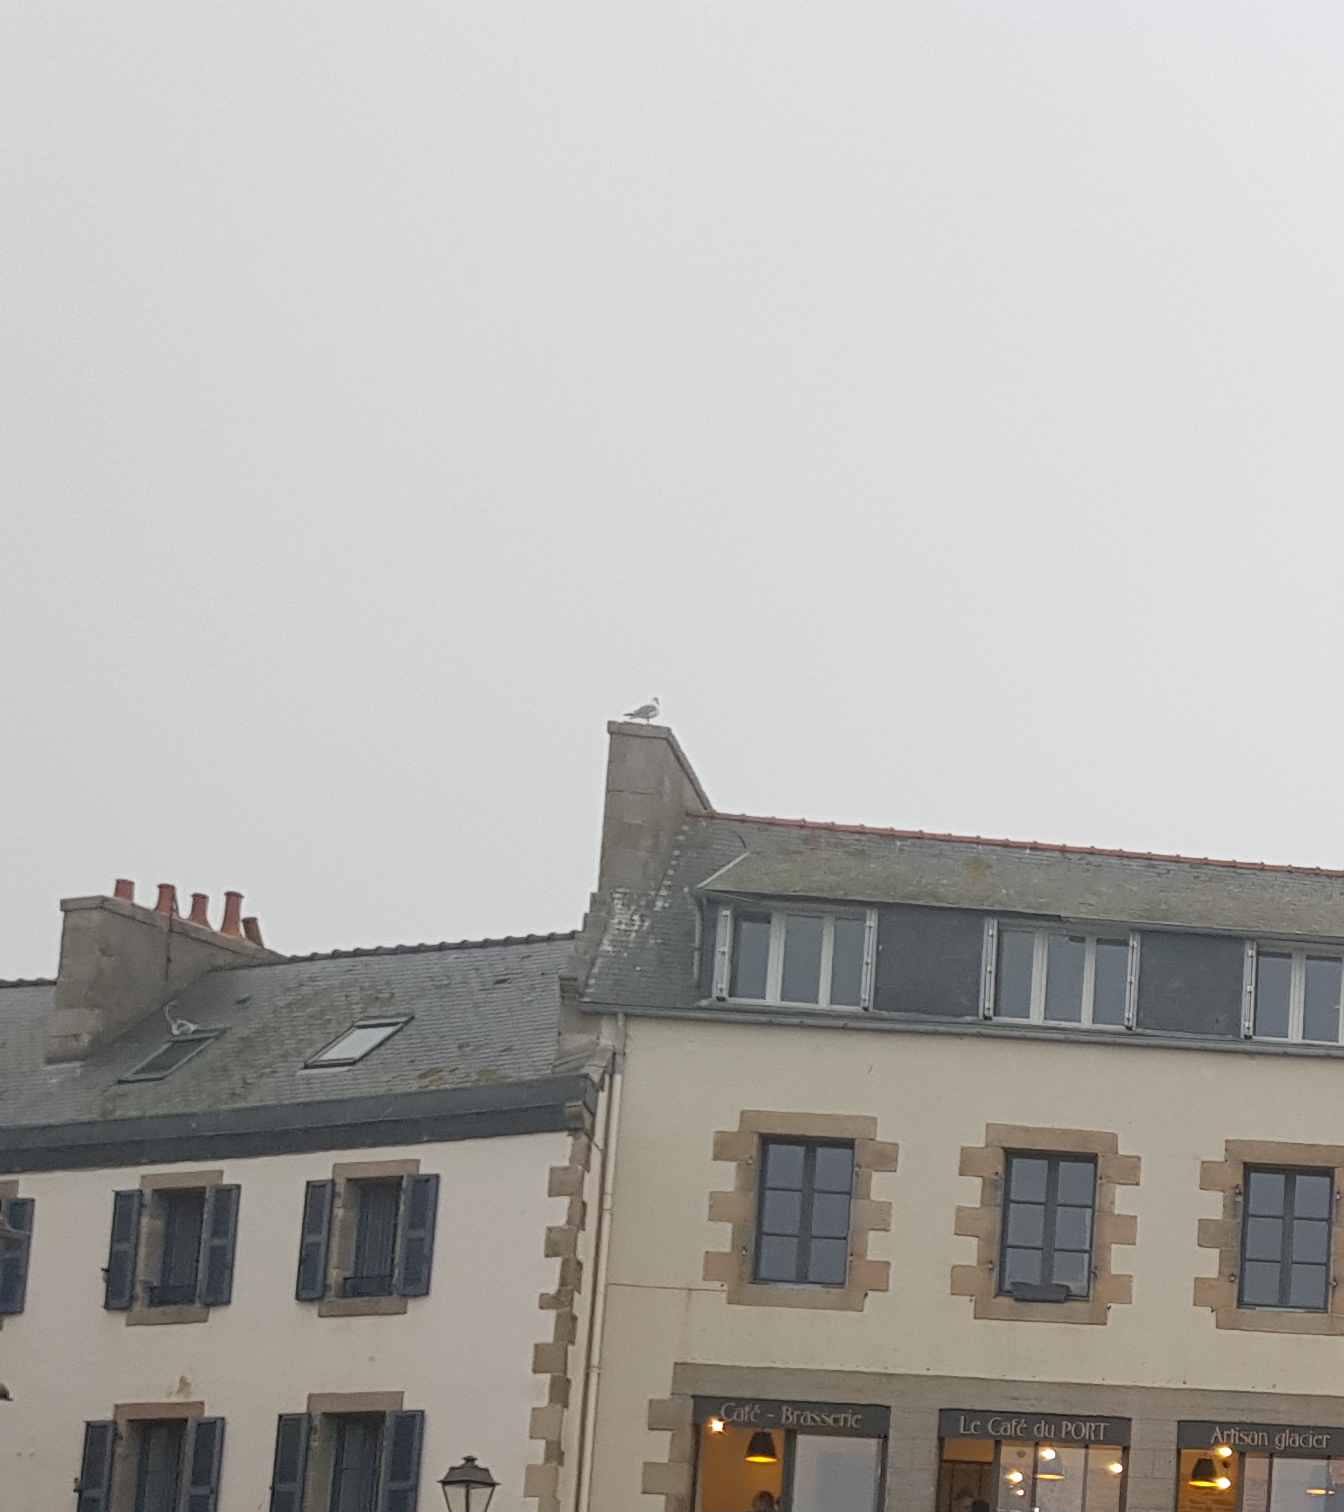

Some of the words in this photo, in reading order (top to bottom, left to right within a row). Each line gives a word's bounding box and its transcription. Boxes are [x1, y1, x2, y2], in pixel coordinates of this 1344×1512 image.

[720, 1402, 761, 1422] Café
[780, 1405, 863, 1429] Brasserie
[959, 1415, 981, 1435] Le
[987, 1416, 1028, 1437] Café
[1034, 1419, 1055, 1438] du
[1061, 1420, 1110, 1441] PORT
[1211, 1426, 1269, 1446] Artisan
[1274, 1429, 1331, 1451] glacier
